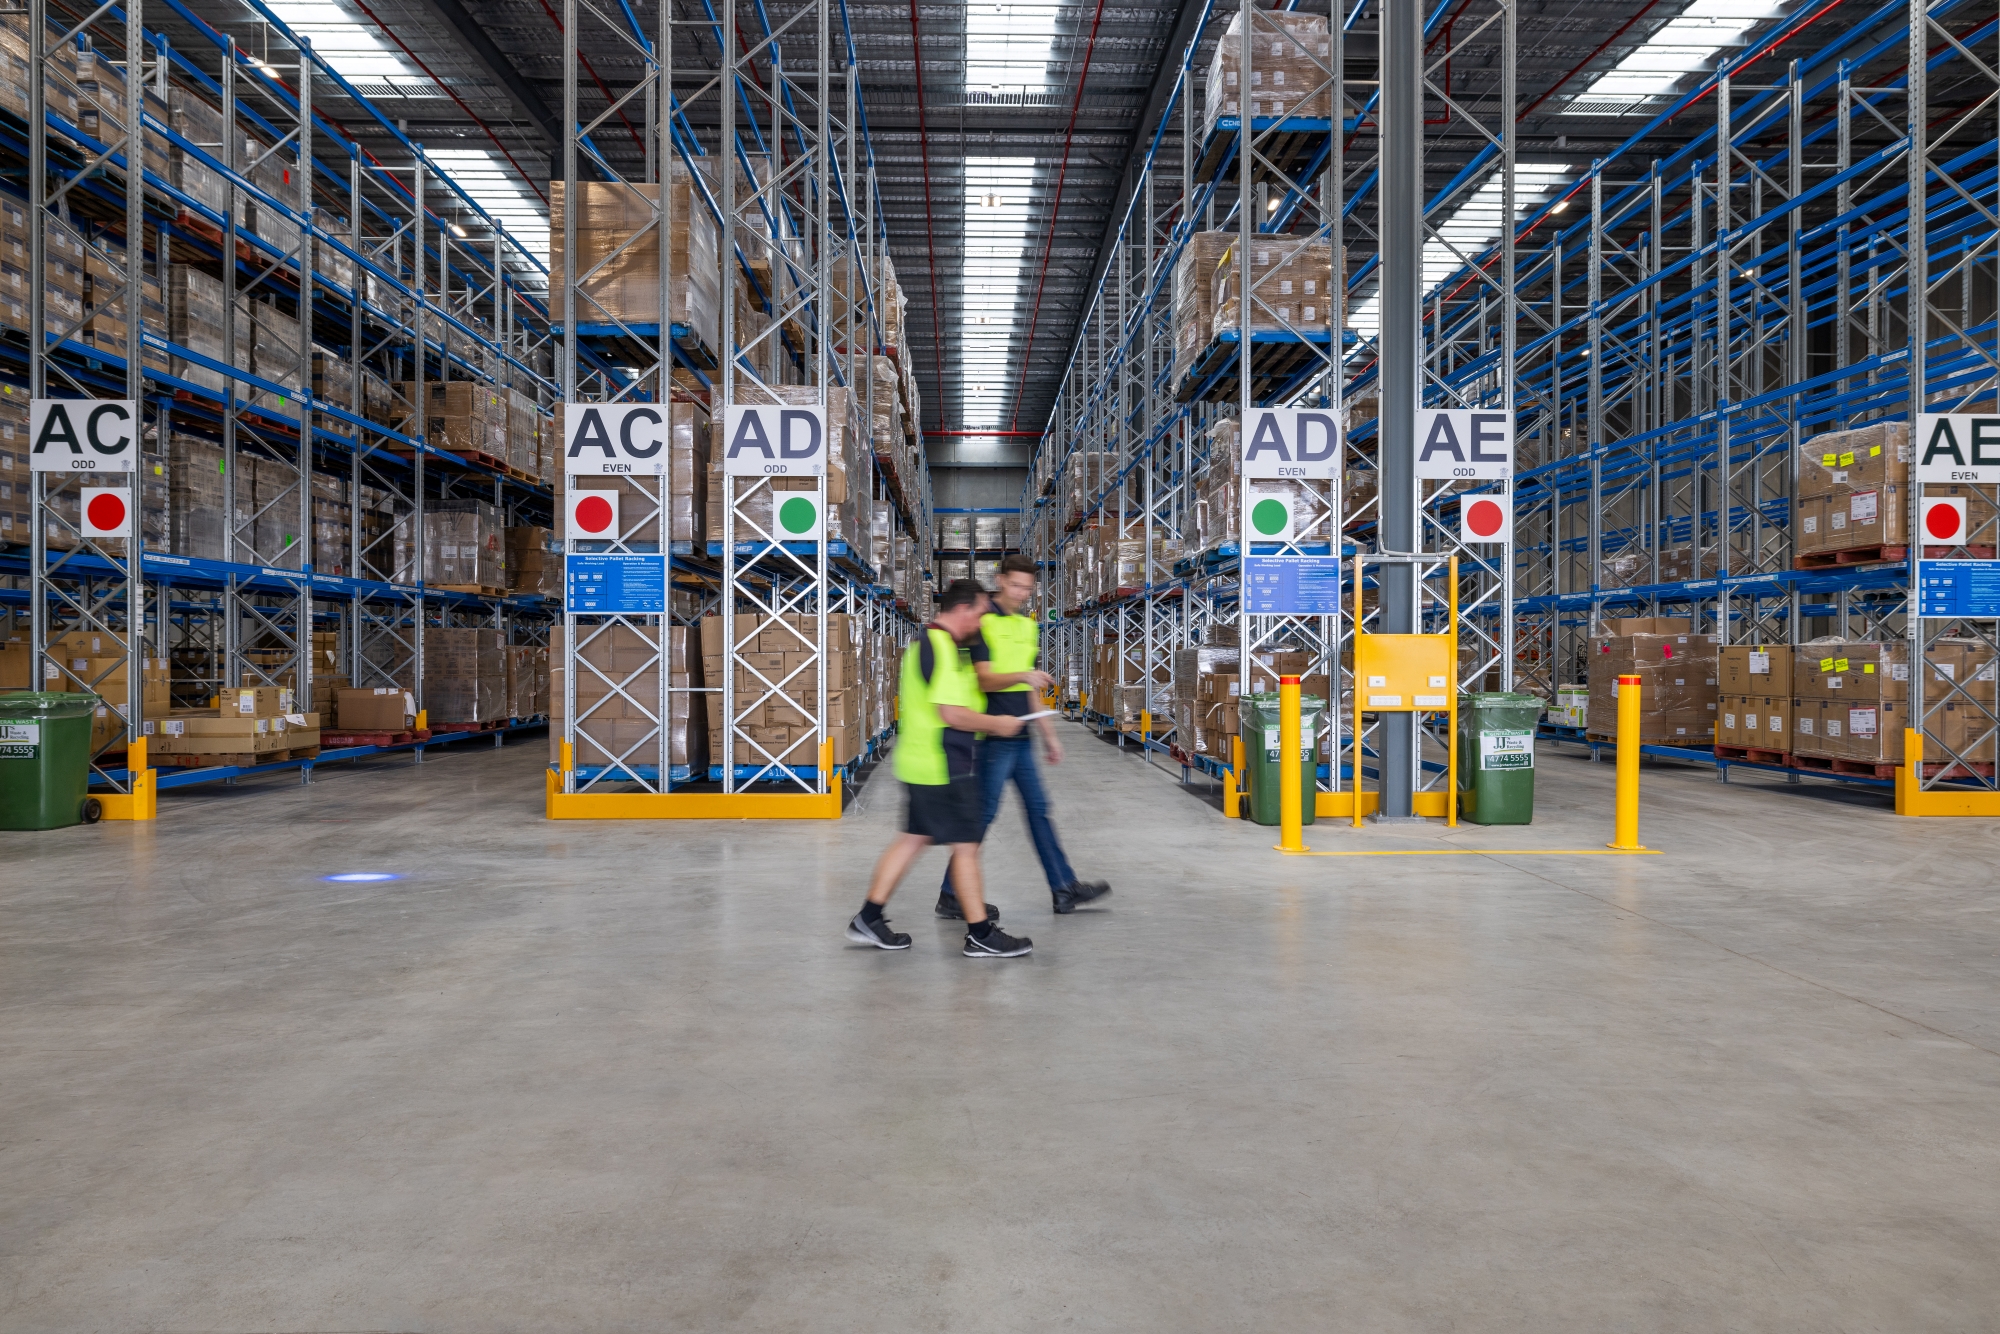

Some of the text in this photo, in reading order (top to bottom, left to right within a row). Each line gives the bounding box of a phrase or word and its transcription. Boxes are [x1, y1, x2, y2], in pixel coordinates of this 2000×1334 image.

[32, 404, 131, 455] AC
[567, 408, 663, 459] AC
[726, 409, 822, 459] AD
[1244, 412, 1338, 462] AD
[1418, 413, 1508, 463] AE
[1920, 417, 2000, 467] AE
[71, 460, 96, 469] ODD
[602, 463, 632, 473] EVEN
[763, 464, 788, 474] ODD
[1278, 467, 1306, 476] EVEN
[1452, 468, 1476, 477] ODD
[1951, 471, 1979, 481] EVEN
[13, 746, 35, 754] 5555
[1510, 753, 1529, 762] 5555
